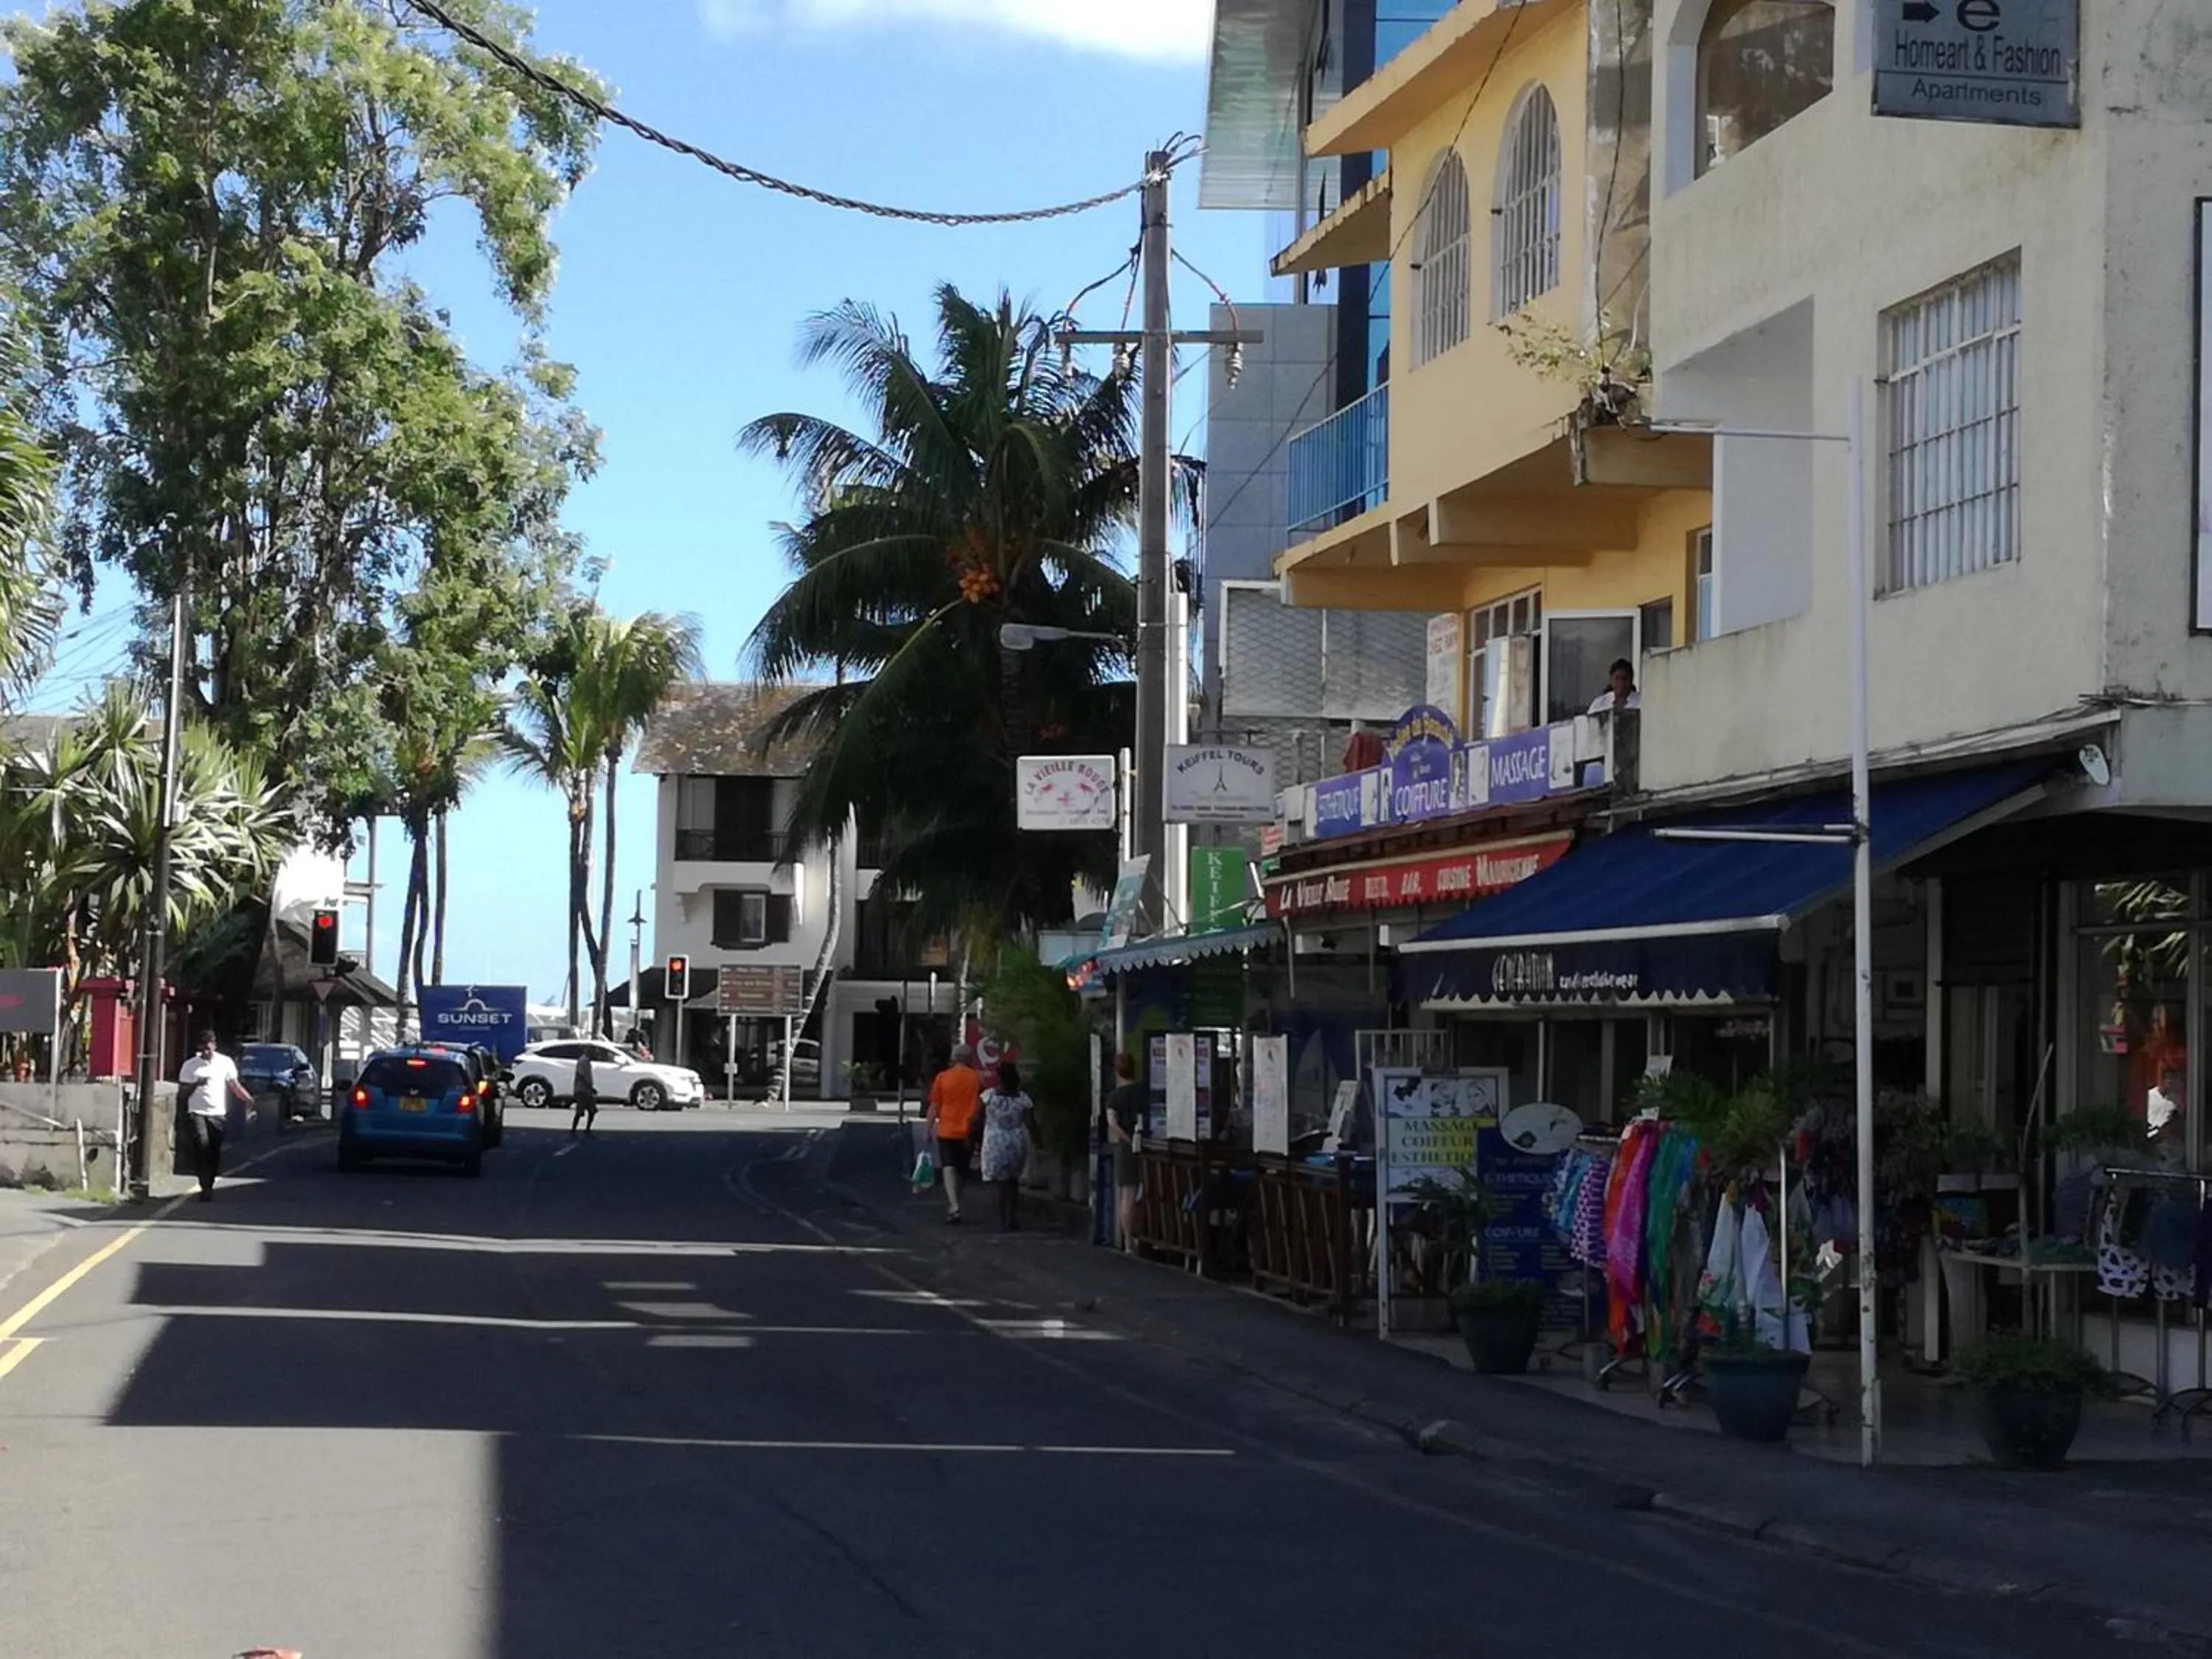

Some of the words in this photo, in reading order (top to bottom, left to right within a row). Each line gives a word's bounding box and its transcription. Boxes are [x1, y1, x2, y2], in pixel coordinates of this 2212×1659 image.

[1895, 29, 1969, 70] Homeart
[1975, 36, 1986, 71] &
[1994, 35, 2061, 74] Fashion
[1911, 78, 2042, 105] Apartments
[1228, 750, 1265, 775] TOURS
[1490, 745, 1546, 787] MASSAGE
[1395, 779, 1447, 815] COIFFURE
[437, 1013, 512, 1024] SUNSET
[1402, 1135, 1473, 1147] COIFFUR
